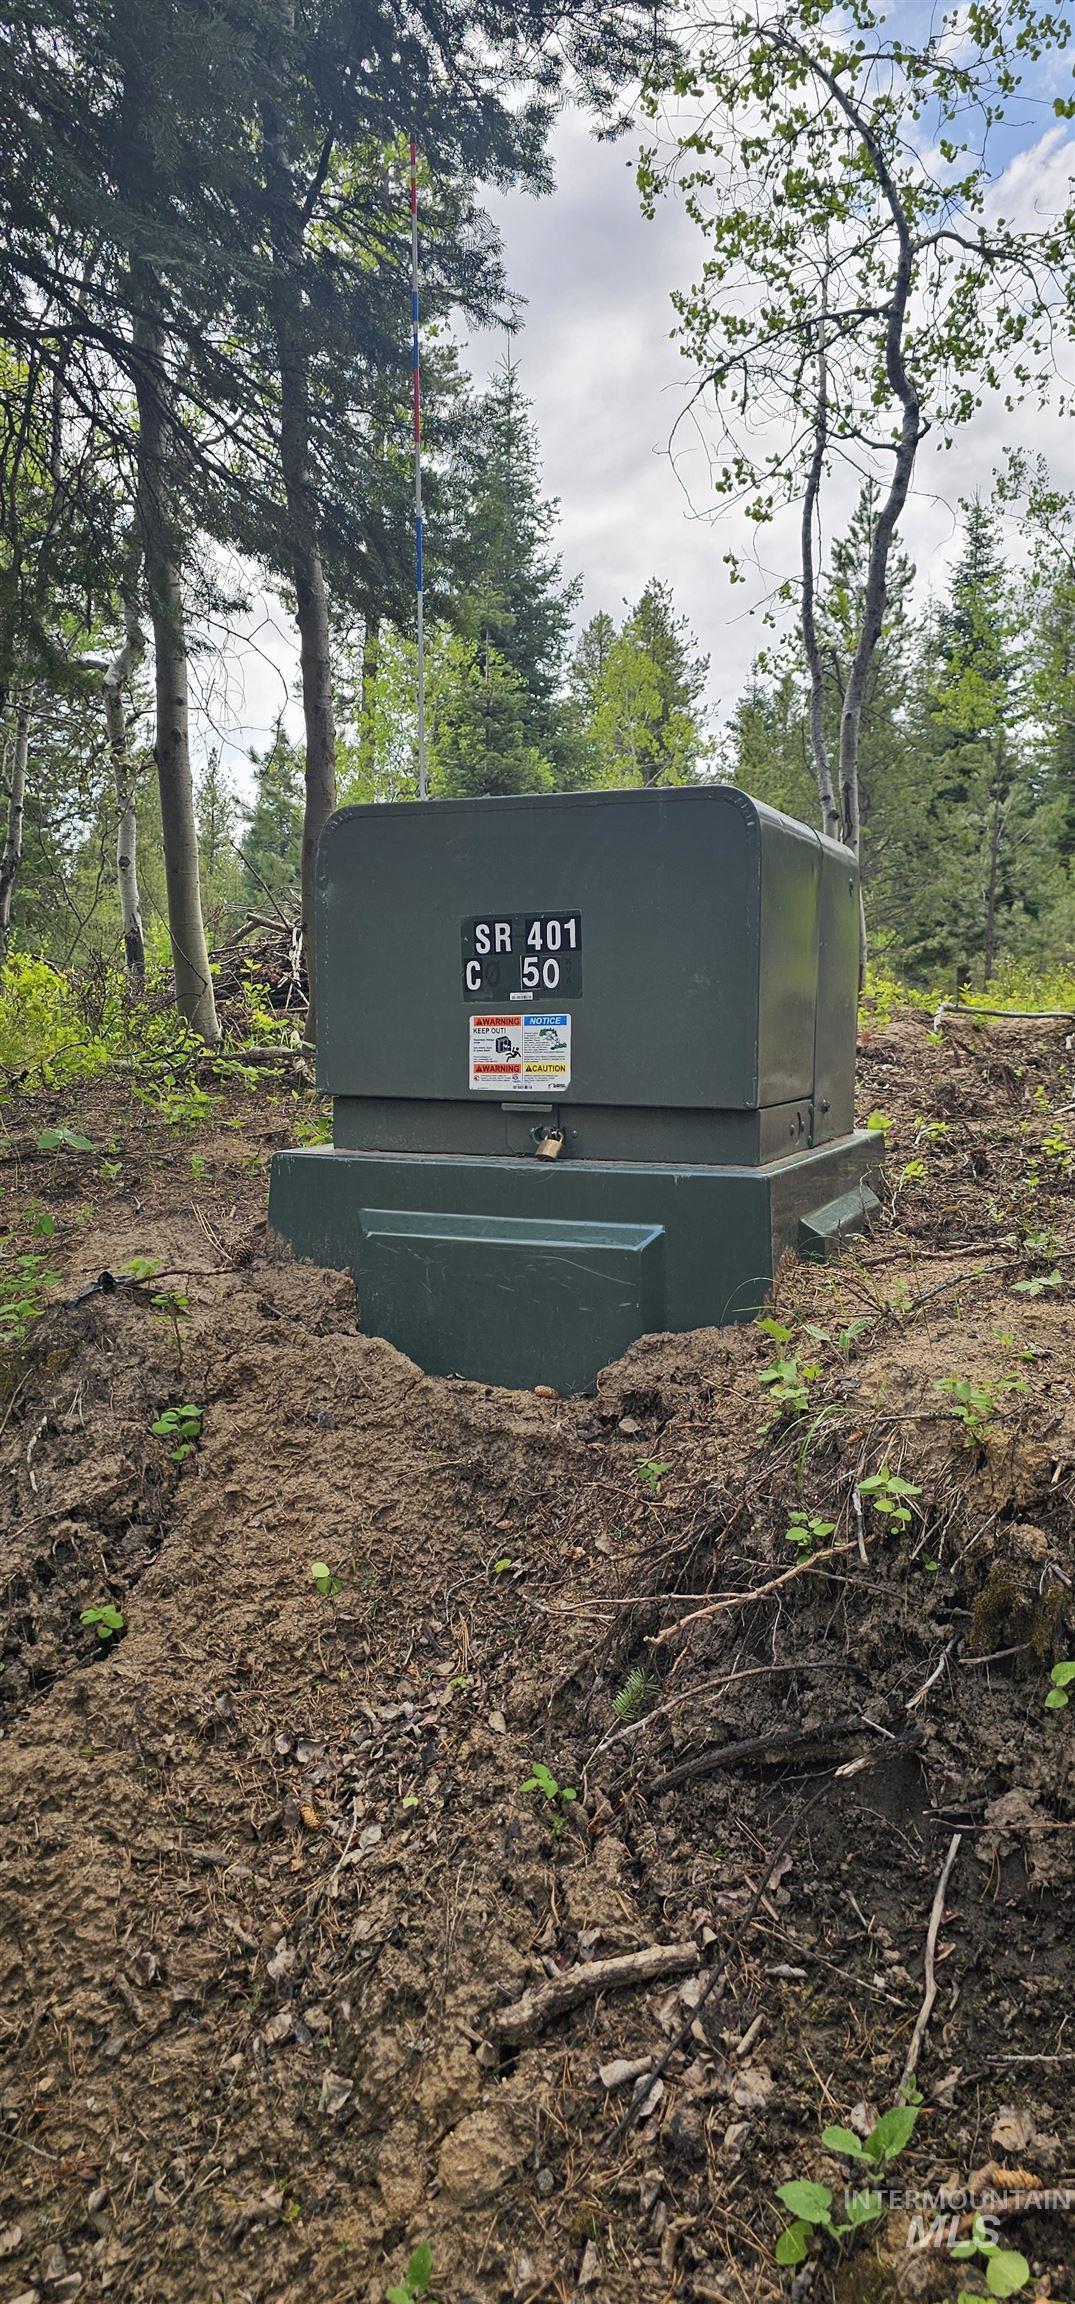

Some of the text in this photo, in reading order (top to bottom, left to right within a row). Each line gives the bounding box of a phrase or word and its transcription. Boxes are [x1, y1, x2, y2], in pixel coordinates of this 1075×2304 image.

[475, 918, 577, 954] SR 401
[522, 956, 560, 989] 50
[482, 1017, 520, 1026] WARNING
[529, 1017, 562, 1025] NOTICE
[473, 1027, 490, 1035] KEEP
[482, 1065, 520, 1073] WARNING
[532, 1064, 566, 1072] CAUTION
